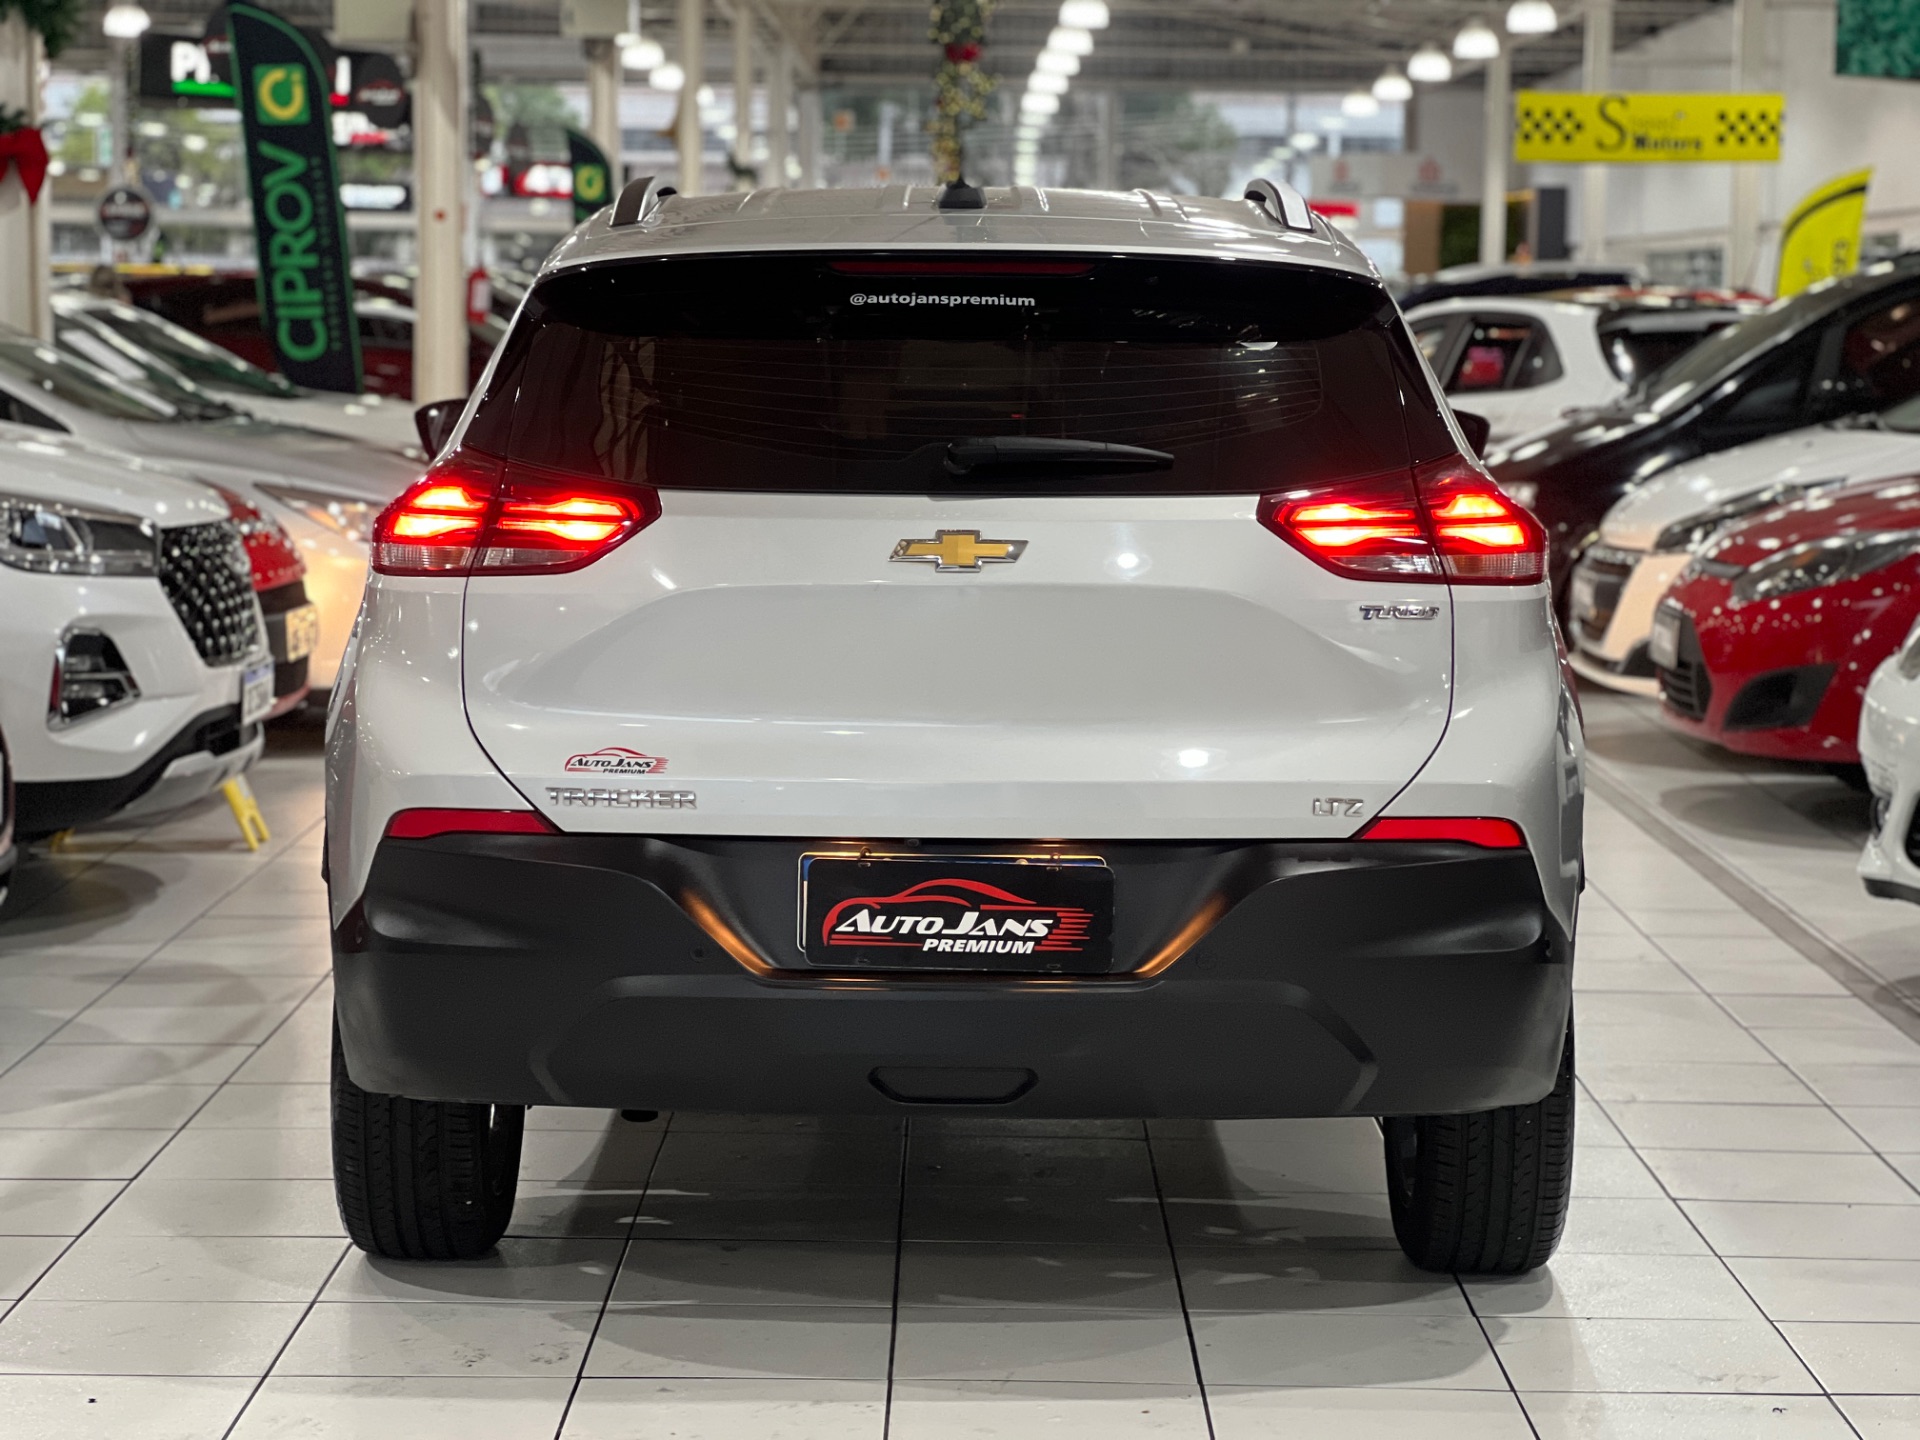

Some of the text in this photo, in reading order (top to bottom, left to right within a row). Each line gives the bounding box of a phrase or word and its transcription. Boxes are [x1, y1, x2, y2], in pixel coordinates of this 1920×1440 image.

[258, 139, 328, 361] CIPROV
[850, 292, 1035, 307] @autojanspremium
[1359, 605, 1440, 620] TURBO
[545, 787, 698, 810] TRACKER
[1313, 798, 1363, 817] LTZ
[922, 938, 1035, 954] PREMIUM
